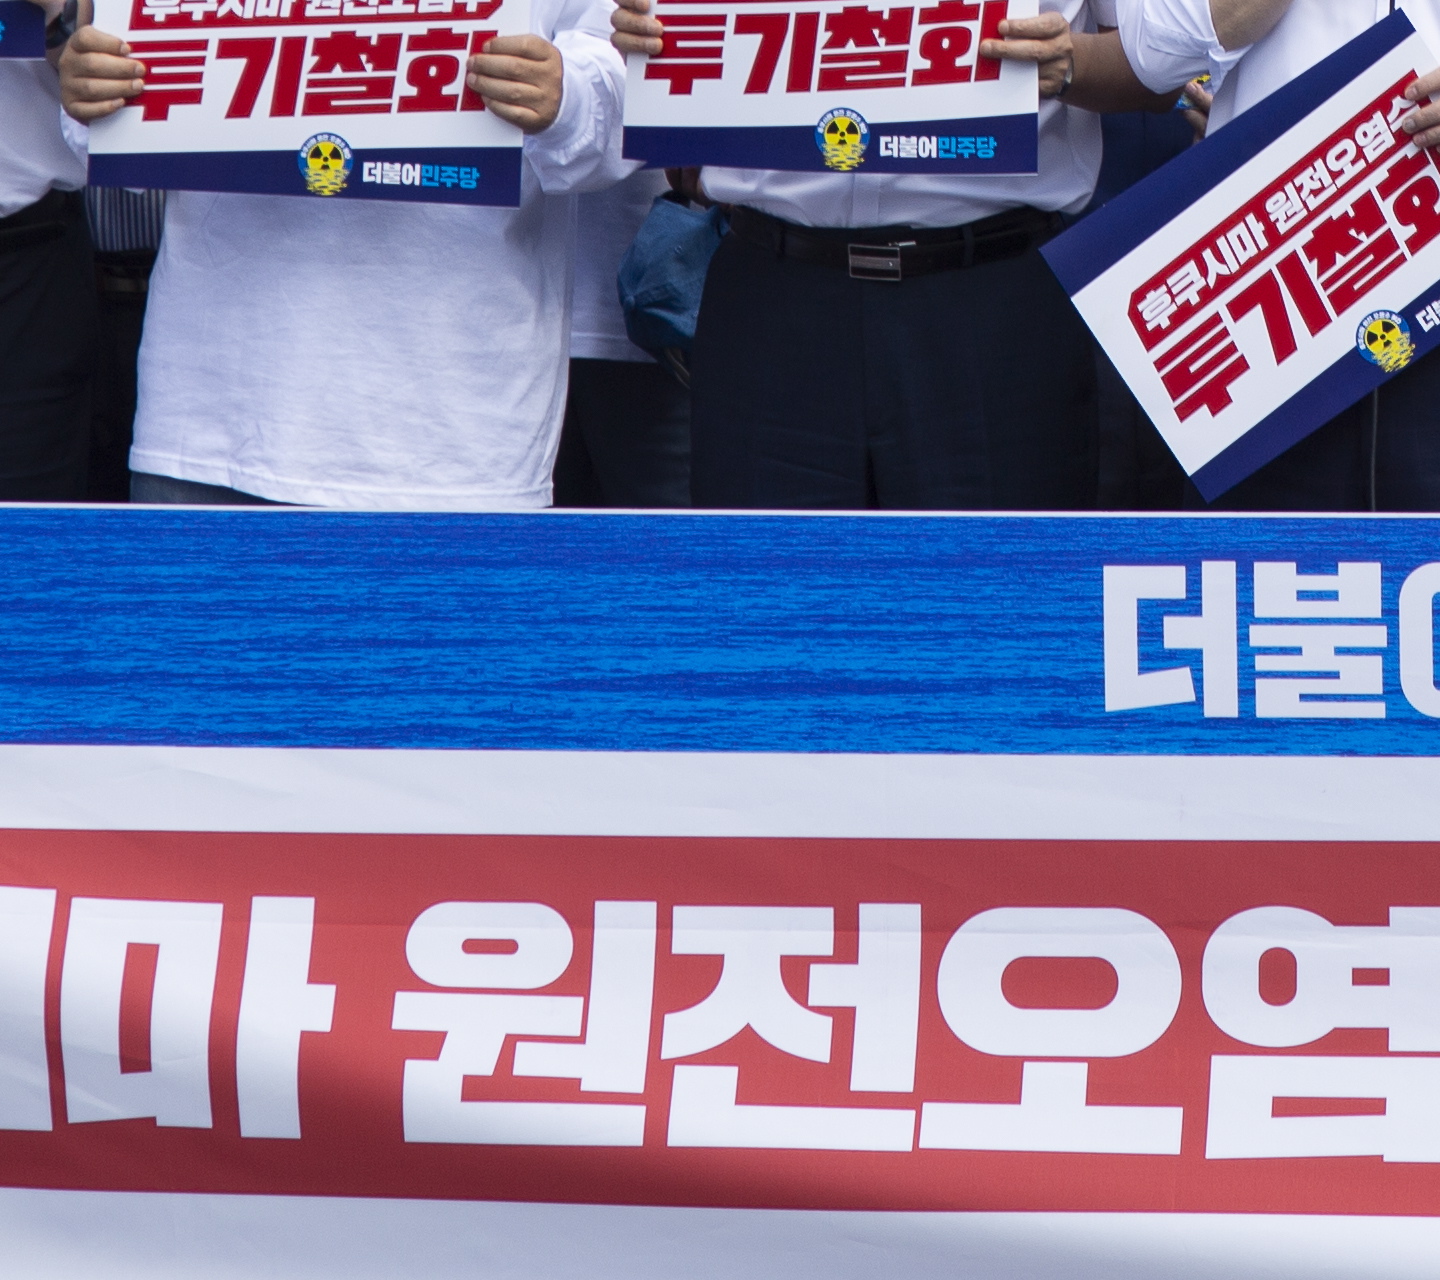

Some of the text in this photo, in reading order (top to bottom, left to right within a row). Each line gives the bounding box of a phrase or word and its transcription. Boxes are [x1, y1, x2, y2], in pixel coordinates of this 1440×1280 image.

[124, 28, 498, 121] 투기철회
[645, 0, 1008, 95] 투기철회
[362, 162, 480, 188] 더불어민주당
[879, 135, 997, 159] 더불어민주당
[1141, 222, 1270, 329] 후쿠시마
